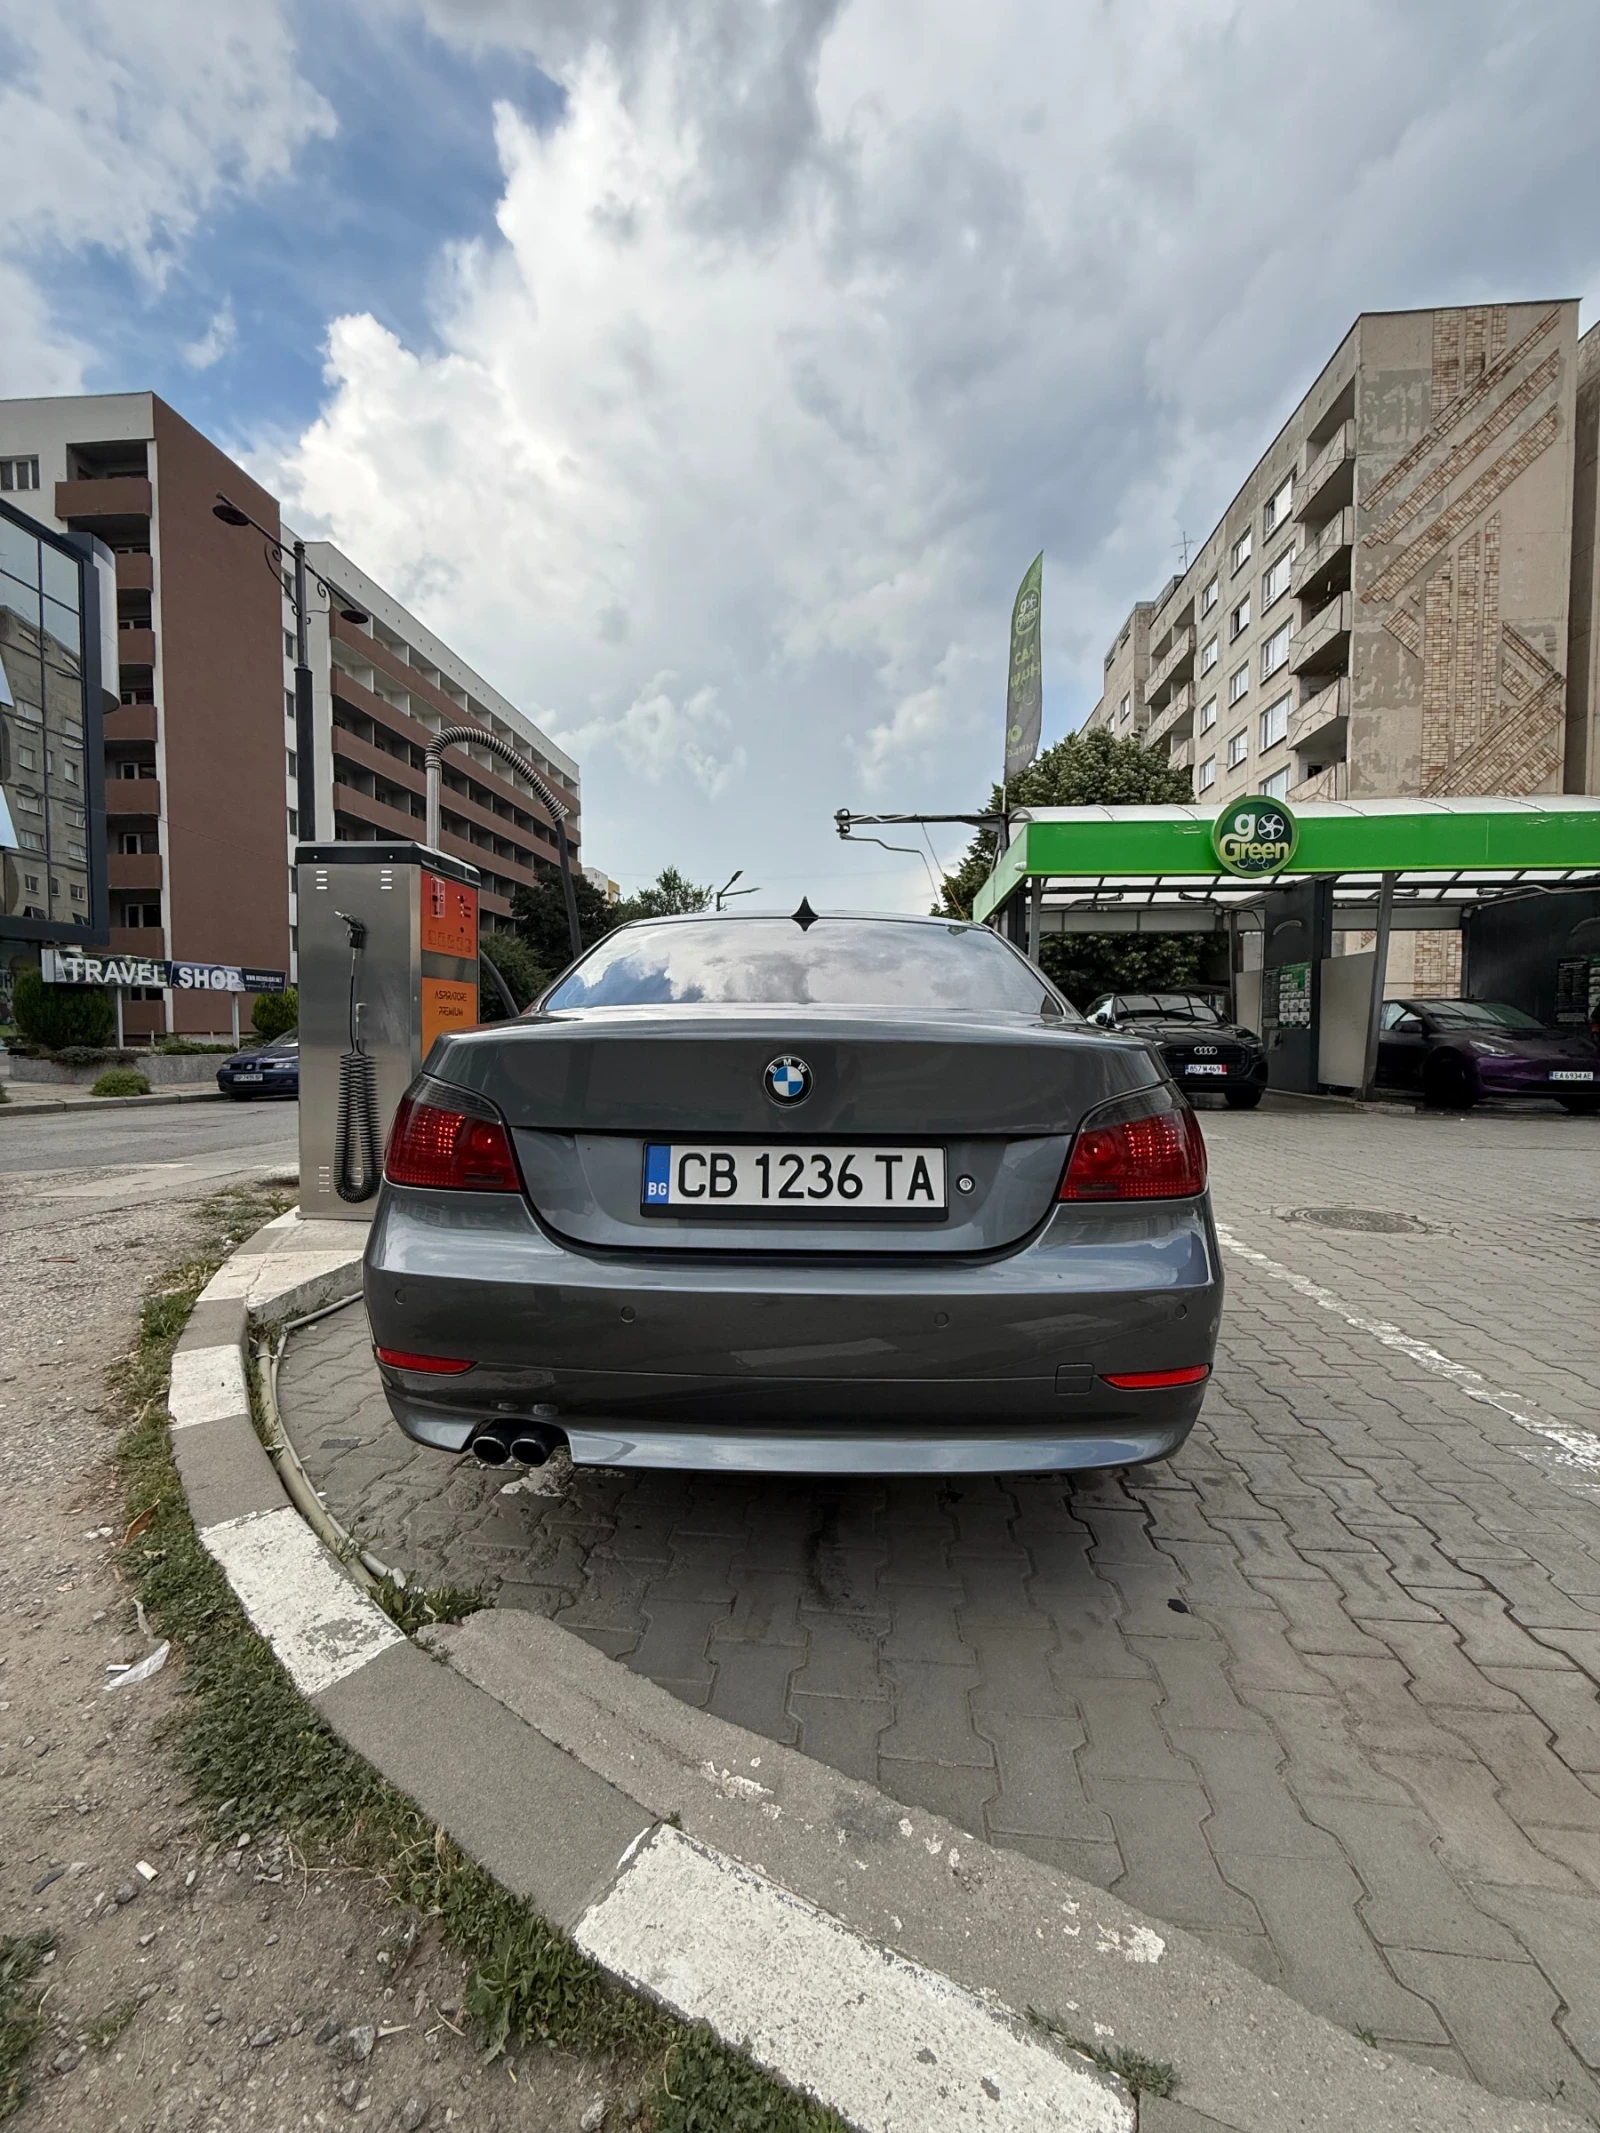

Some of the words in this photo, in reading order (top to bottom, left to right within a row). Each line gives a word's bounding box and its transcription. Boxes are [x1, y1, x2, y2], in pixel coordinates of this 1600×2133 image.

[1014, 643, 1035, 666] CAR
[1010, 662, 1041, 688] WASH
[1007, 724, 1022, 744] 10
[1234, 813, 1285, 842] go
[1219, 833, 1290, 862] Green
[66, 957, 168, 987] TRAVEL
[178, 966, 240, 991] SHOP
[434, 990, 468, 1002] ASPIRATORE
[438, 1006, 464, 1017] PREMIUM
[768, 1058, 808, 1074] BMW
[1564, 1072, 1582, 1080] 6934
[1583, 1072, 1592, 1080] AE
[647, 1182, 667, 1196] BG
[678, 1152, 738, 1198] CB
[755, 1153, 863, 1200] 1236
[875, 1154, 935, 1201] TA
